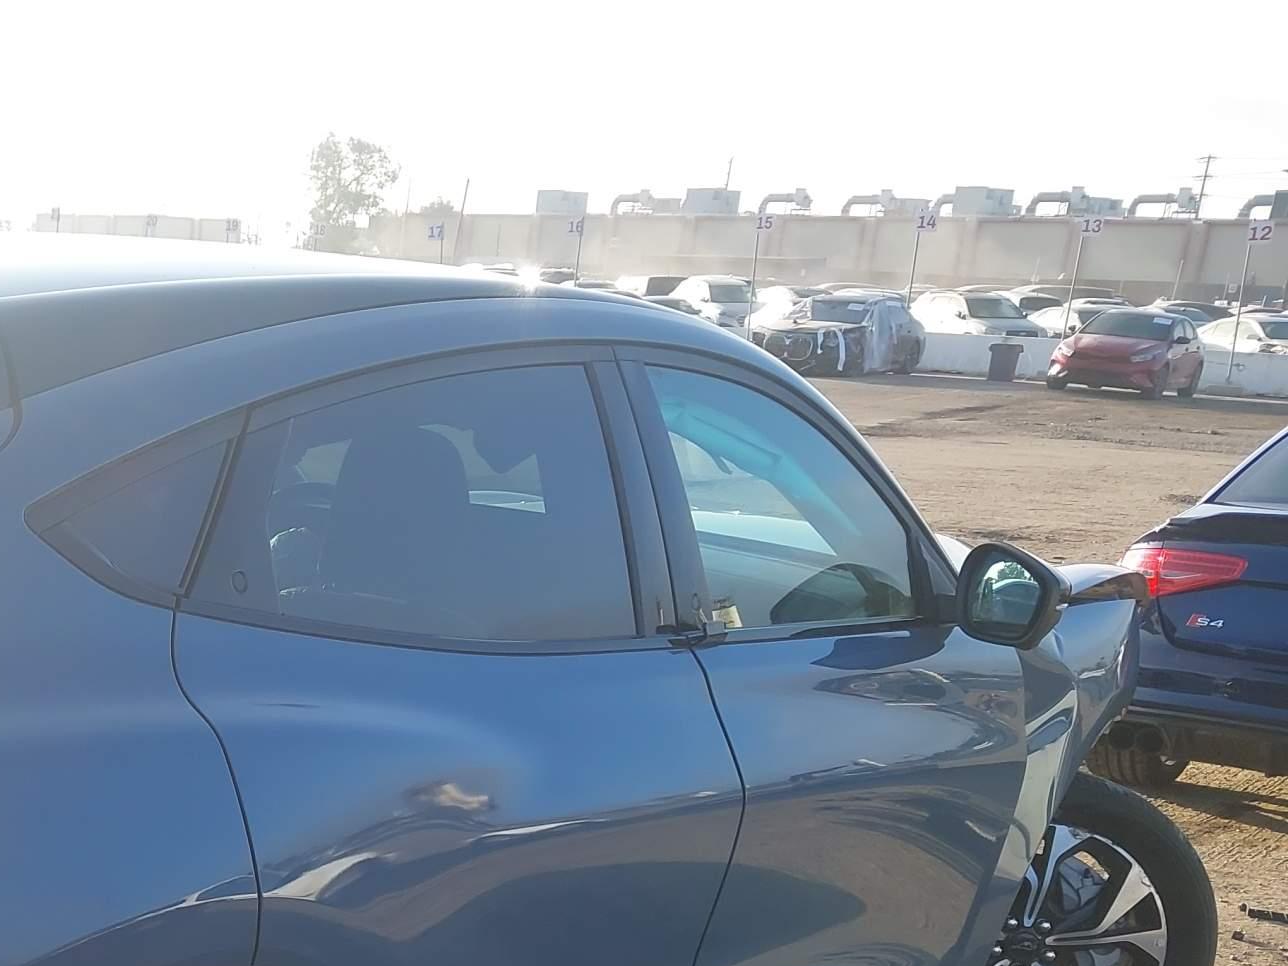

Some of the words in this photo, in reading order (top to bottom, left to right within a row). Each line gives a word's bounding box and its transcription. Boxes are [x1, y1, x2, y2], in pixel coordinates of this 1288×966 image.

[568, 220, 583, 234] 16
[756, 216, 774, 230] 15
[916, 215, 937, 229] 14
[1081, 219, 1102, 233] 13
[428, 226, 443, 239] 17
[1248, 225, 1272, 241] 12
[1194, 616, 1224, 628] S4
